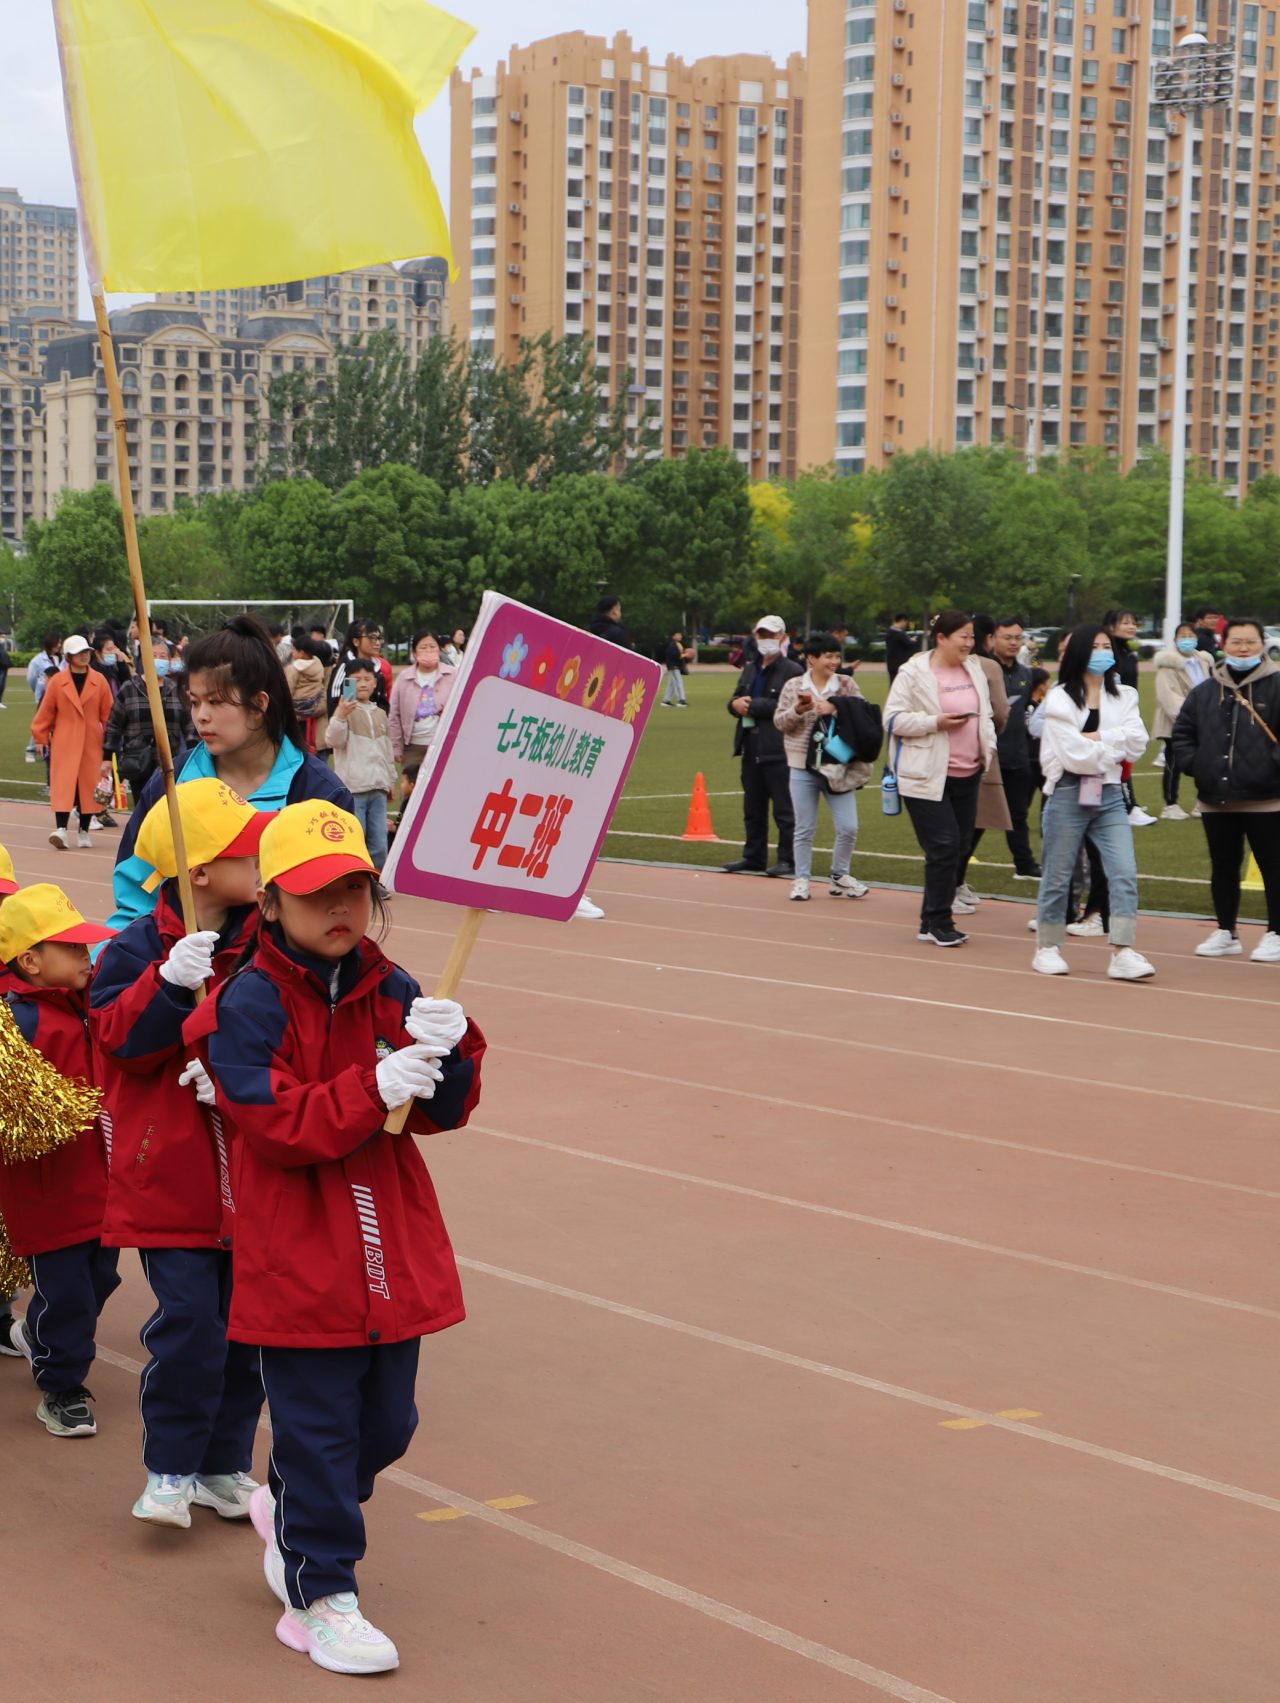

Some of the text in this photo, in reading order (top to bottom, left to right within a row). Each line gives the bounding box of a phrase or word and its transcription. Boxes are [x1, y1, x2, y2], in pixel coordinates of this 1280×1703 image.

[497, 708, 606, 779] 七巧板幼儿教育
[470, 778, 574, 879] 中二班
[364, 1244, 391, 1300] BDT
